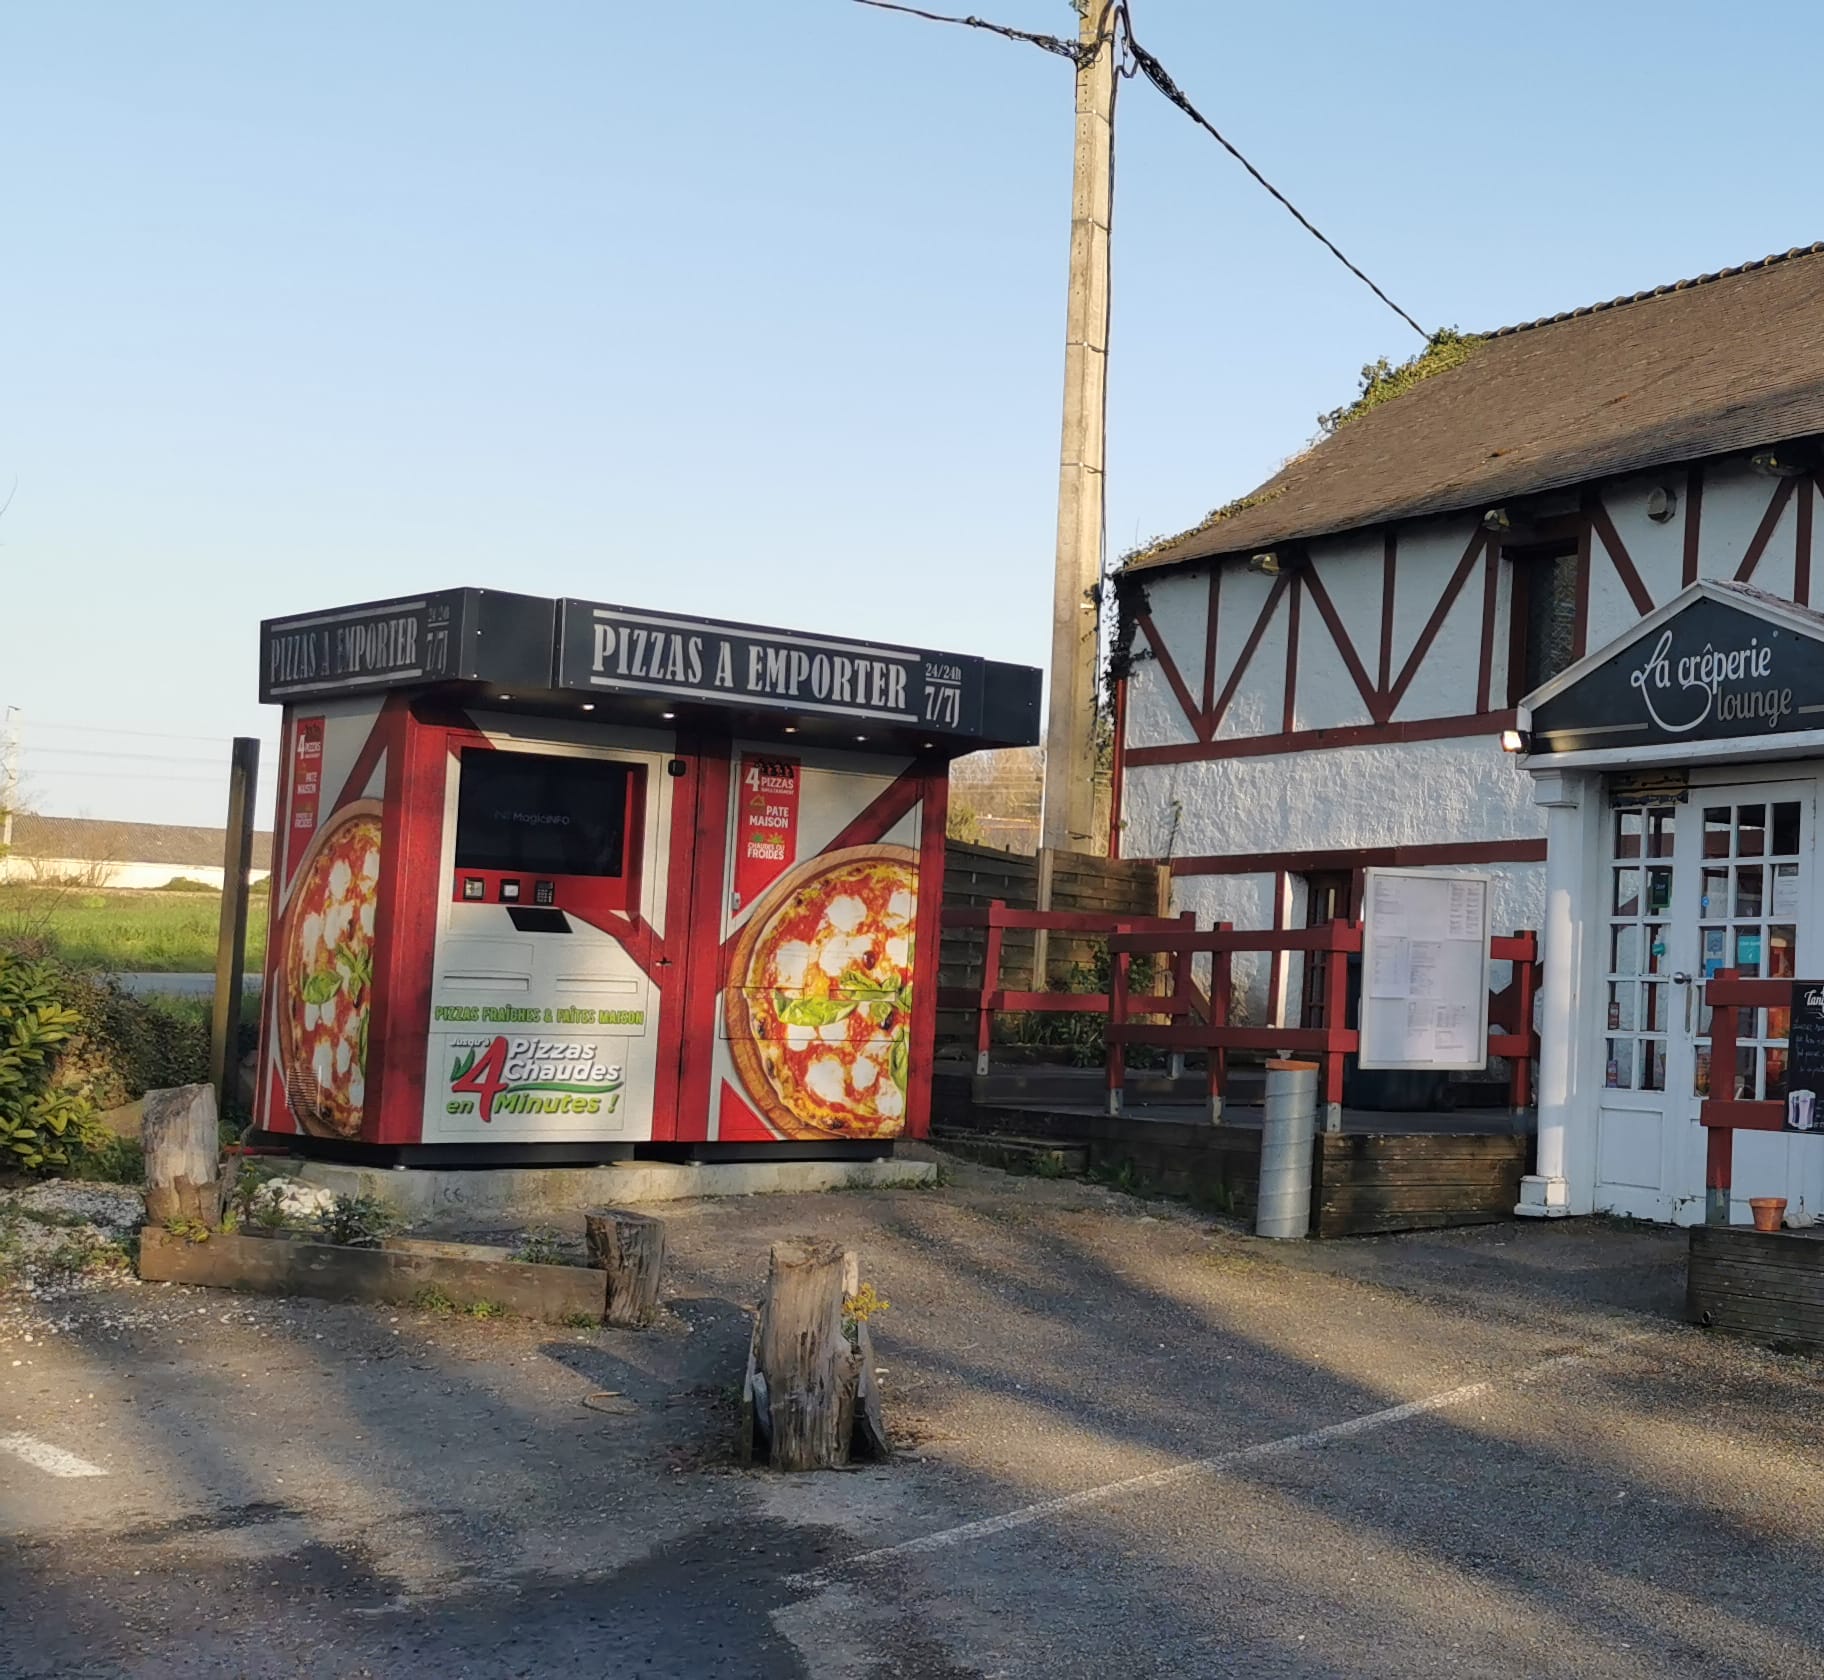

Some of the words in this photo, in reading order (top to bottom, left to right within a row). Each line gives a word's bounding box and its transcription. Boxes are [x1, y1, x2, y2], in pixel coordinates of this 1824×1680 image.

[270, 633, 317, 682] PIZZAS
[321, 632, 330, 675] A
[337, 616, 418, 673] EMPORTER
[592, 623, 704, 685] PIZZAS
[714, 641, 734, 688] A
[747, 645, 908, 709] EMPORTER
[925, 662, 962, 680] 24/24h
[1678, 637, 1772, 696] crêperie
[924, 686, 960, 728] 7/7J
[1717, 687, 1792, 729] lounge
[745, 768, 760, 792] 4
[761, 777, 795, 789] PIZZAS
[749, 815, 788, 828] MAISON
[766, 805, 789, 817] PATE
[747, 848, 784, 860] FROIDES
[435, 1005, 479, 1022] PIZZAS
[543, 1008, 553, 1023] &
[599, 1010, 645, 1025] MAISON
[451, 1036, 510, 1123] 4
[509, 1038, 597, 1060] Pizzas
[505, 1059, 622, 1082] Chaudes
[446, 1097, 475, 1115] en
[494, 1093, 602, 1115] Minutes
